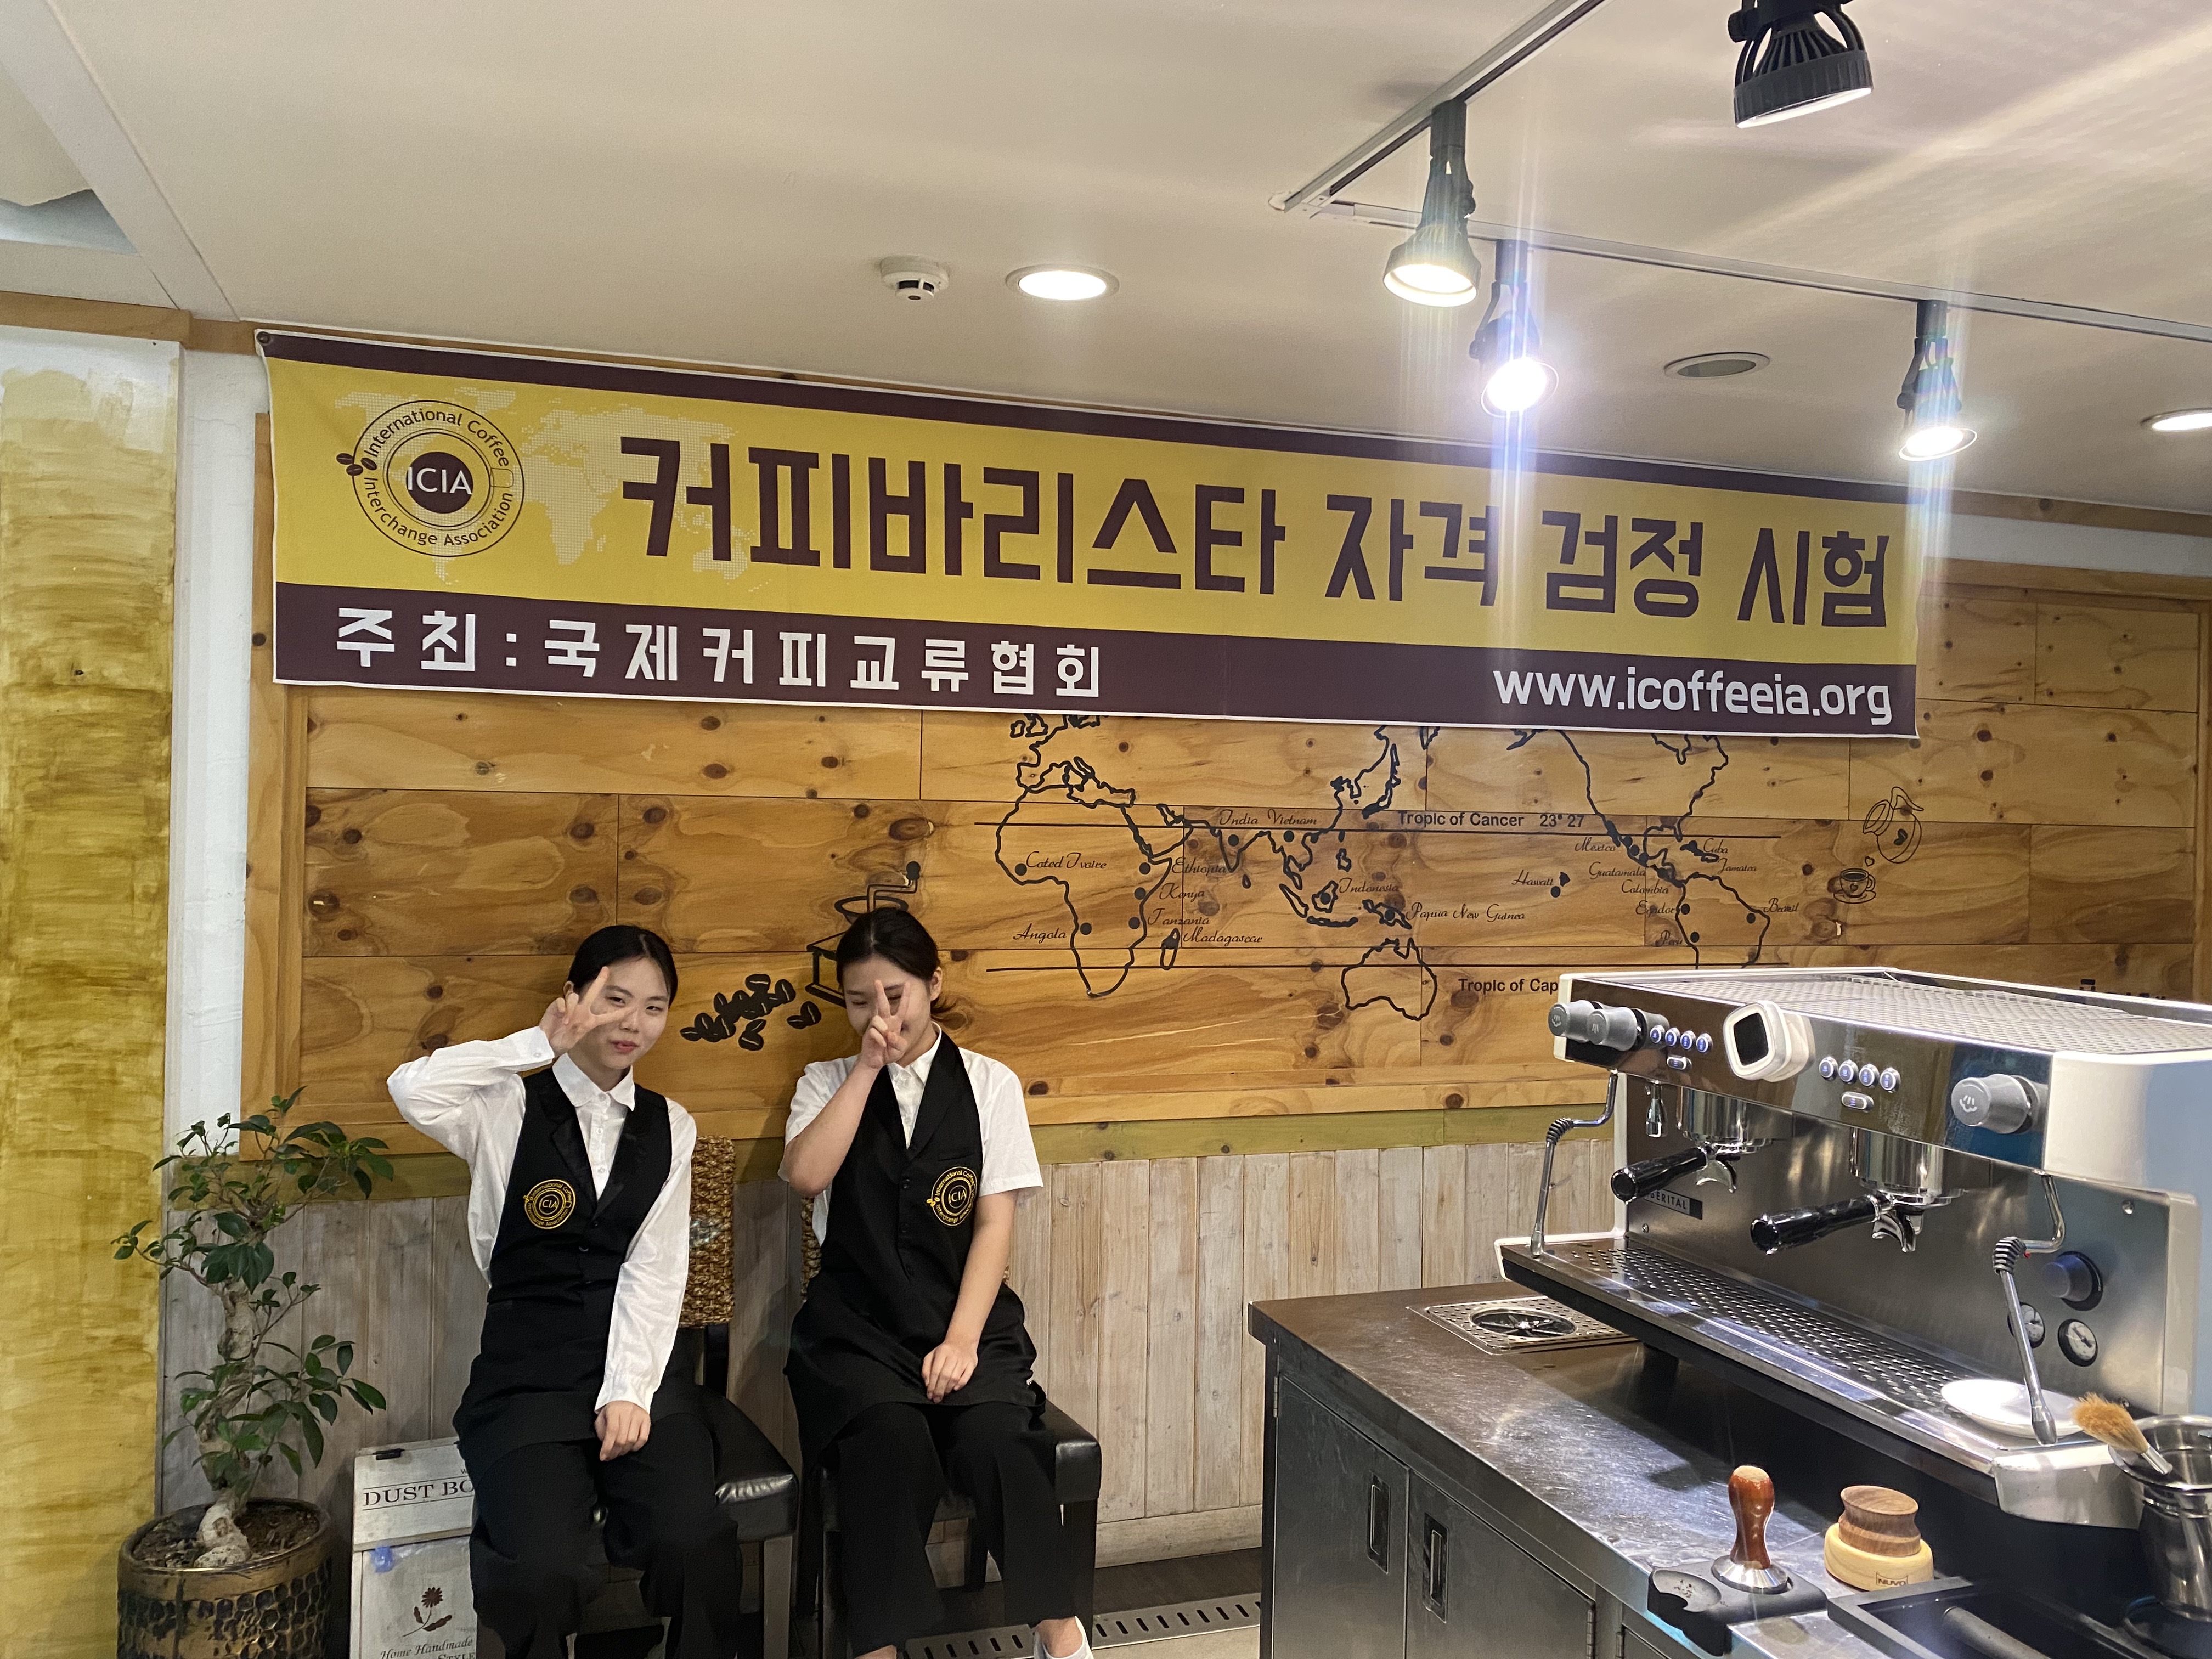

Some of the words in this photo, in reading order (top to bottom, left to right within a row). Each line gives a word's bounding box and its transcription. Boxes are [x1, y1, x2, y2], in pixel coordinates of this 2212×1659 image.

[364, 409, 462, 457] International
[467, 420, 509, 466] Coffee
[407, 467, 473, 495] ICIA
[364, 477, 438, 546] Interchange
[444, 493, 514, 546] Association
[620, 436, 1286, 595] 커피바리스타
[1324, 494, 1499, 607] 자격
[1542, 510, 1703, 618] 검정
[1737, 528, 1890, 628] 시험
[1493, 666, 1892, 725] www.icoffeeia.org
[1220, 809, 1258, 825] India
[1267, 809, 1317, 825] Vietnam
[1397, 810, 1446, 827] Tropic
[1449, 812, 1465, 826] of
[1470, 812, 1525, 827] Cancer
[1567, 814, 1585, 828] 27
[1575, 837, 1616, 852] Mexico
[1703, 838, 1729, 854] Cuba
[1717, 857, 1757, 875] Jamaica
[1147, 908, 1210, 926] Tanzania
[1406, 902, 1448, 921] Papua
[1453, 903, 1480, 919] New
[1486, 904, 1526, 923] Guinea
[1013, 923, 1067, 944] Angola
[1183, 926, 1263, 947] Madagascar
[1458, 978, 1505, 995] Tropic
[1510, 978, 1525, 992] of
[1650, 1190, 1687, 1210] BERITAL
[363, 1483, 434, 1506] DUST
[380, 1649, 411, 1659] Home
[414, 1636, 473, 1656] Handmade
